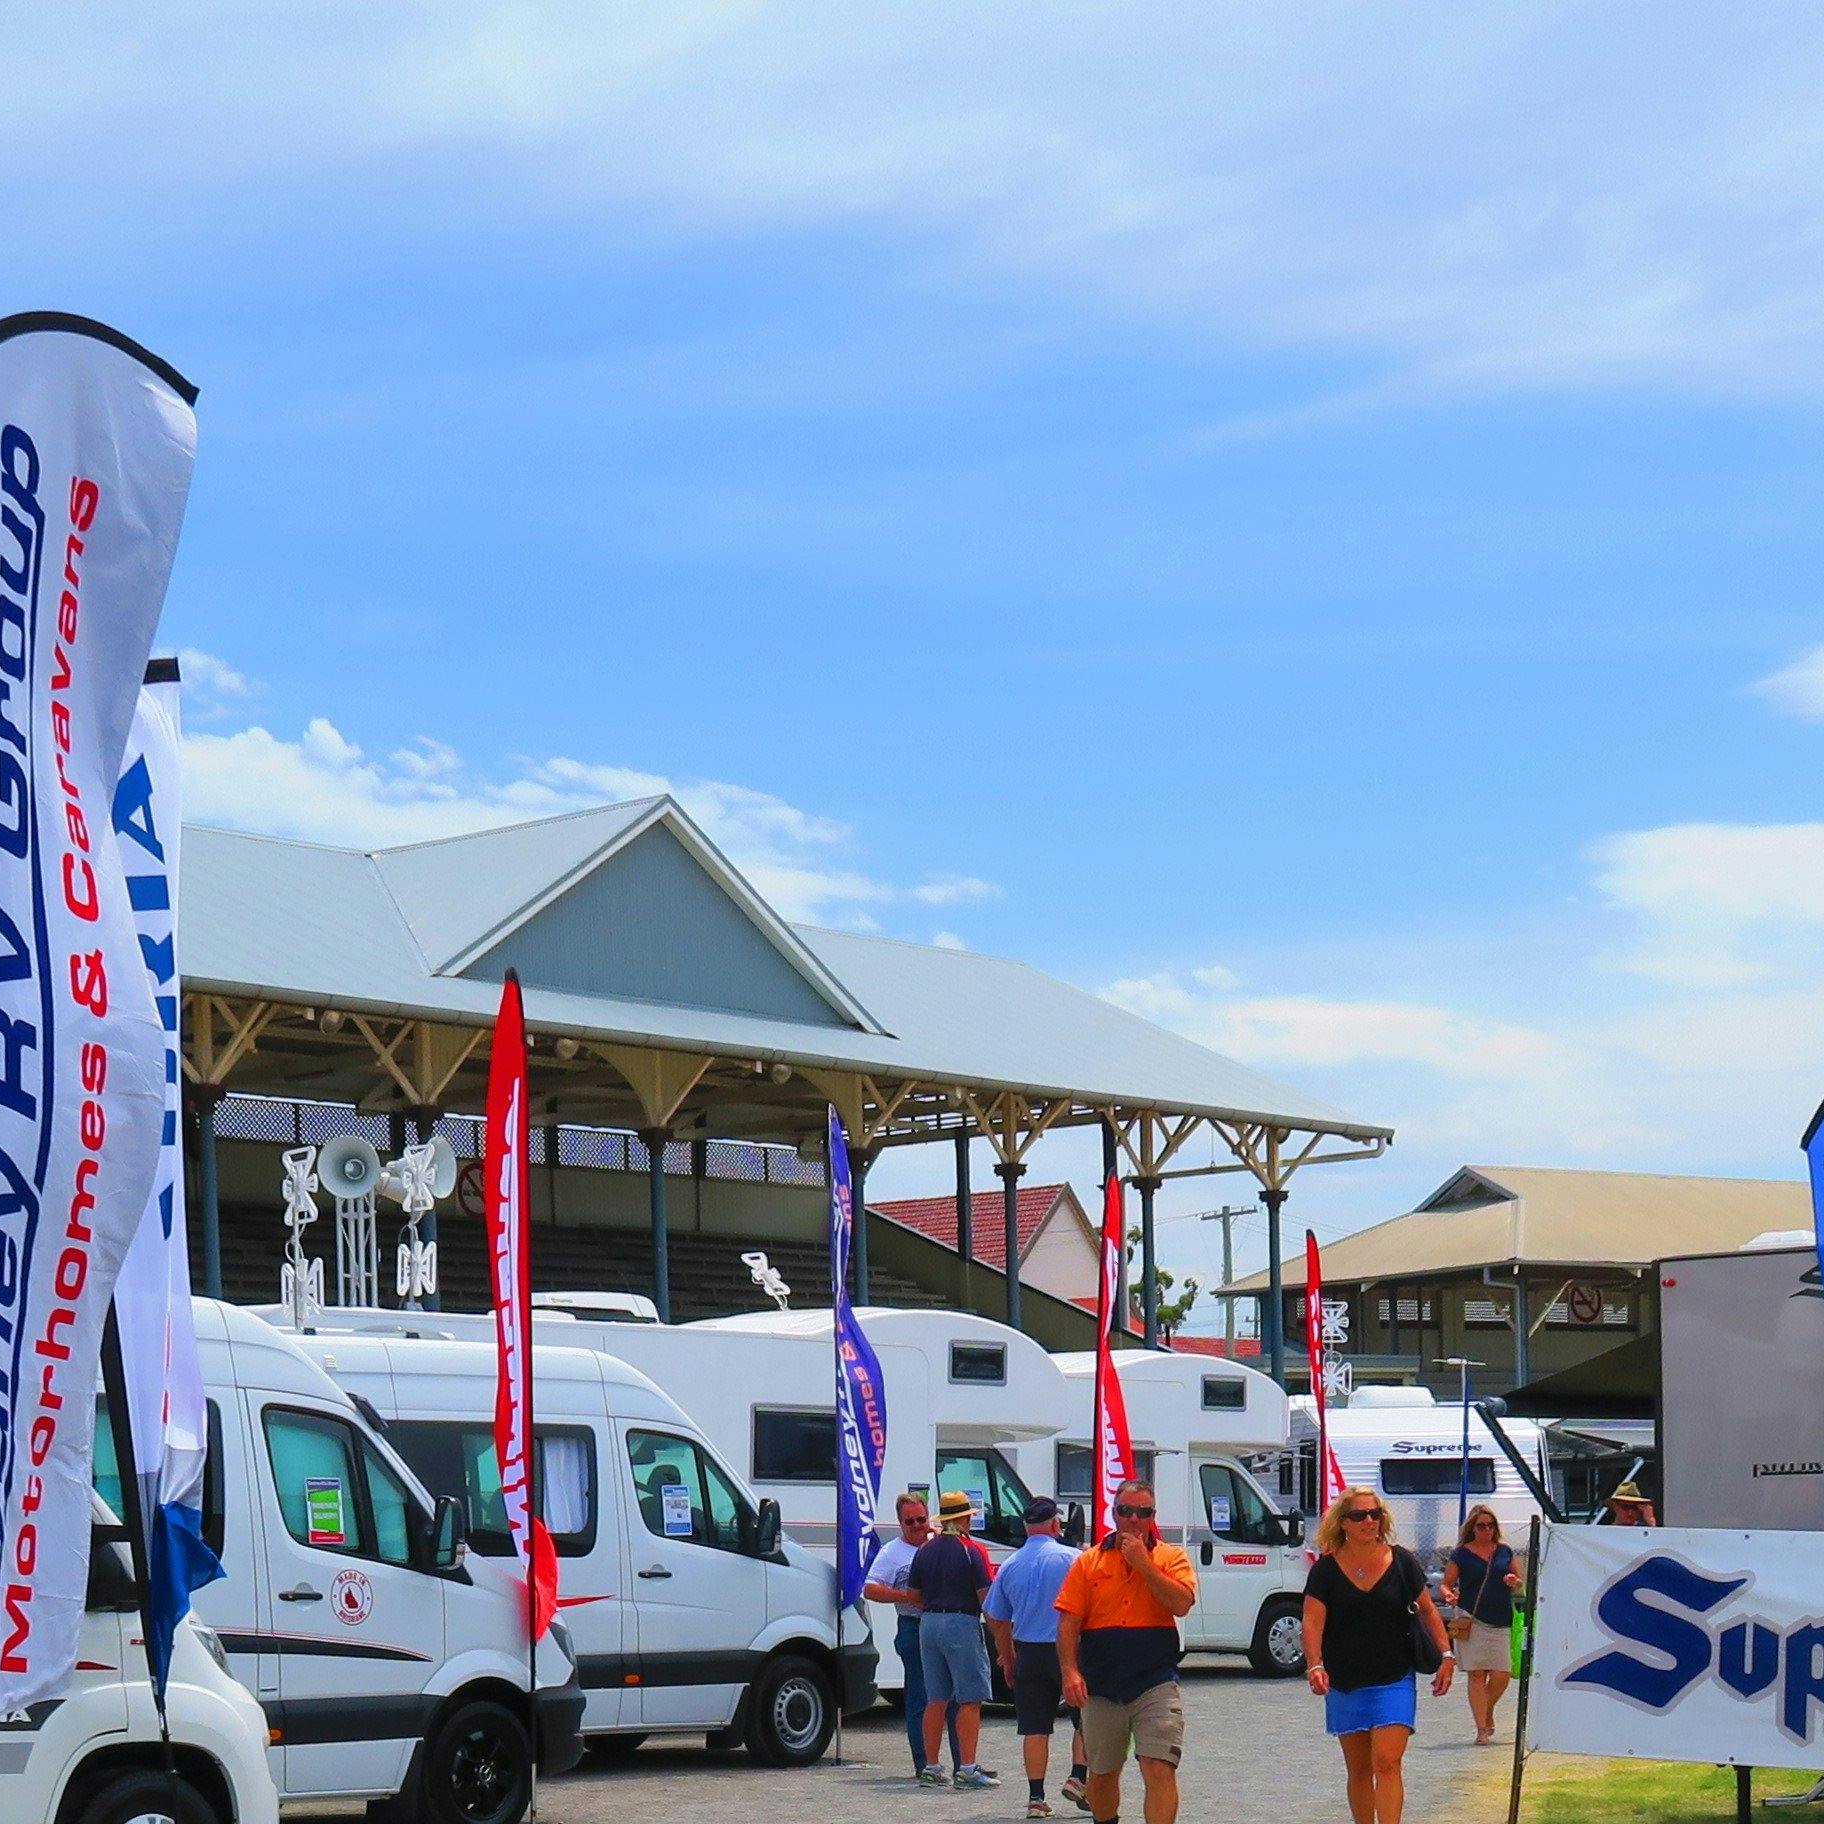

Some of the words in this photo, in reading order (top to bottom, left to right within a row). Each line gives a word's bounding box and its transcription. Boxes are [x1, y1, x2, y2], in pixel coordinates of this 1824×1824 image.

[50, 474, 100, 922] Caravans
[69, 947, 109, 1018] &
[0, 1043, 108, 1674] Motorhomes
